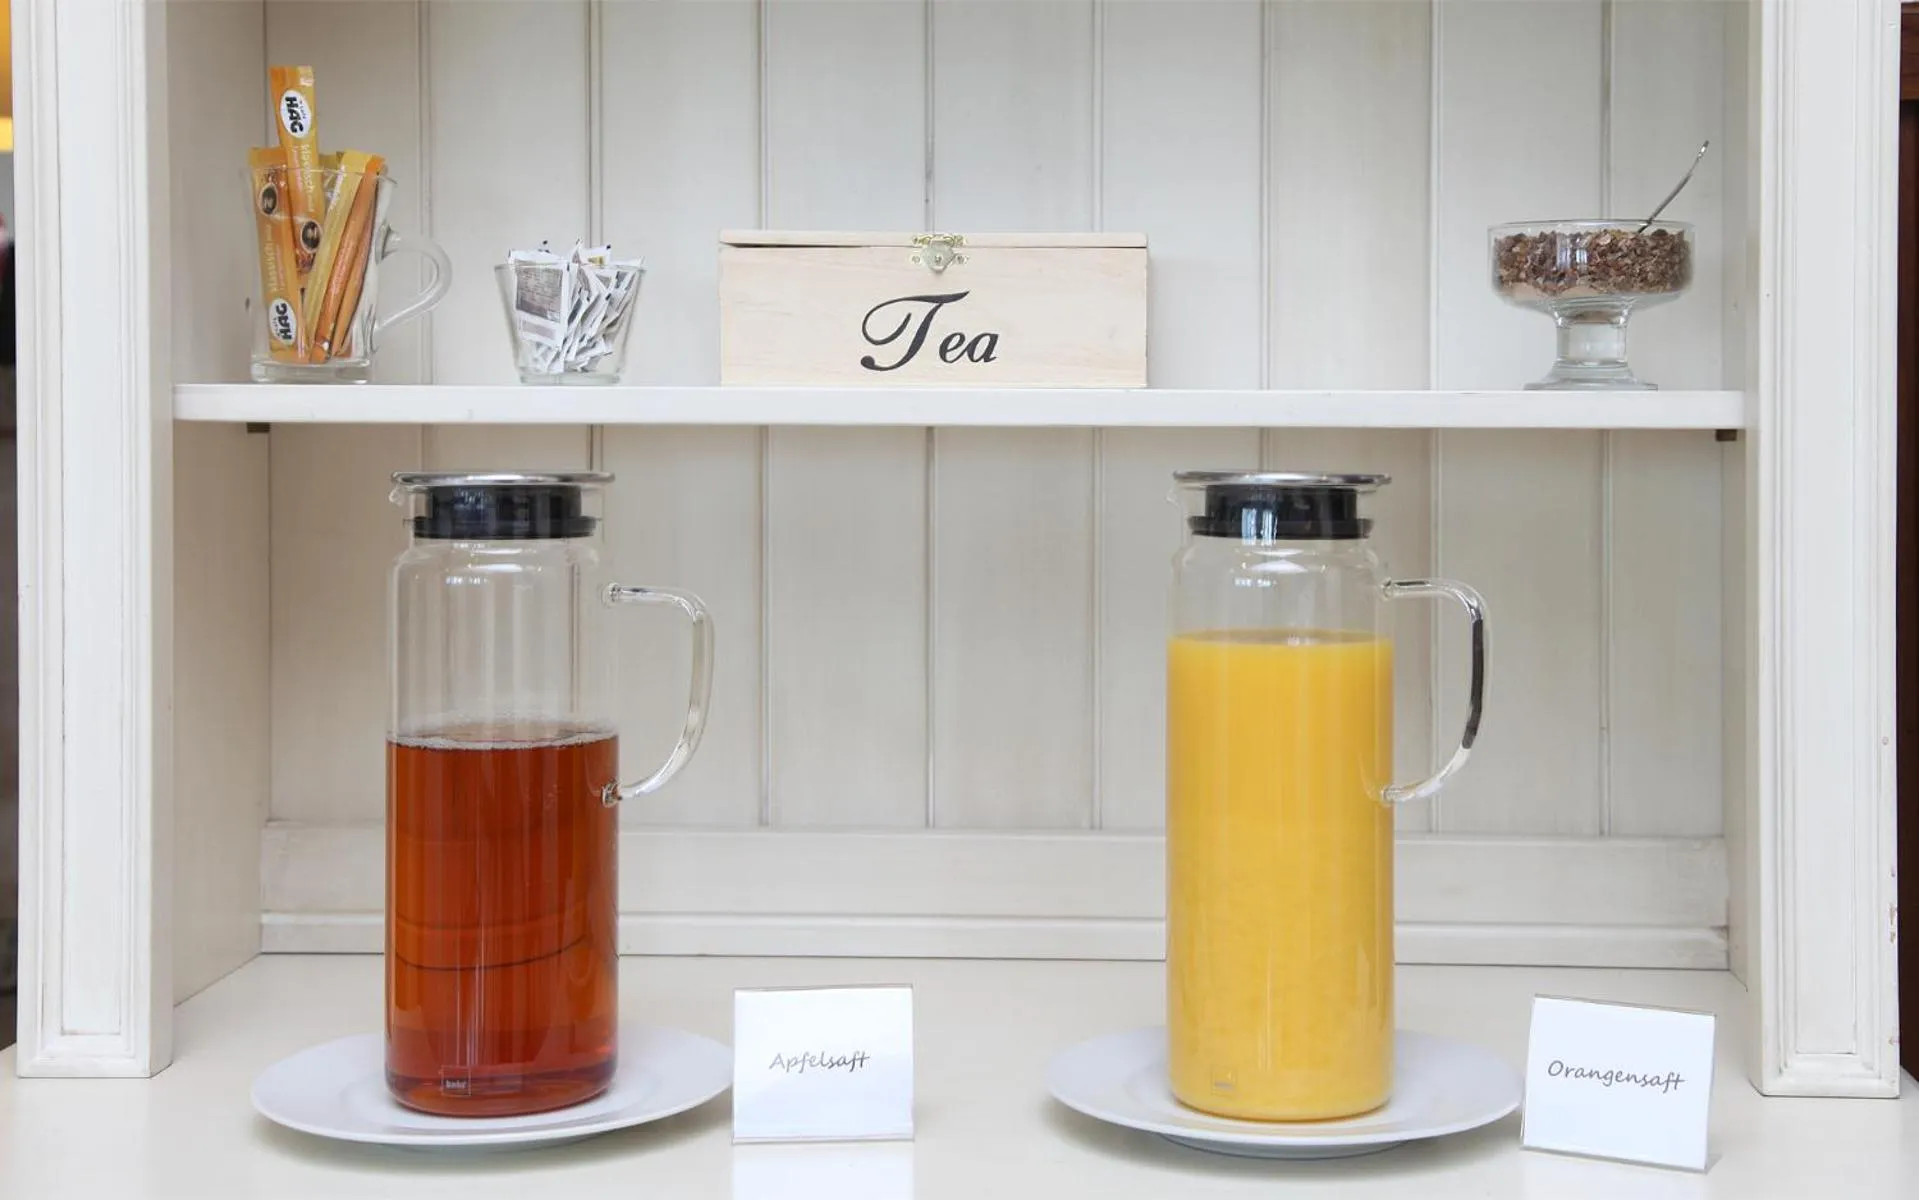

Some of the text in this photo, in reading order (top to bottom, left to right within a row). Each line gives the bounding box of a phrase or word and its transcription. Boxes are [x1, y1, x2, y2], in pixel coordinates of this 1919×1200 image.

[285, 96, 304, 133] HAG
[275, 303, 292, 340] HAG
[860, 290, 999, 372] Tea
[768, 1050, 871, 1074] Apfelsaft
[1547, 1060, 1686, 1094] Orangensaft
